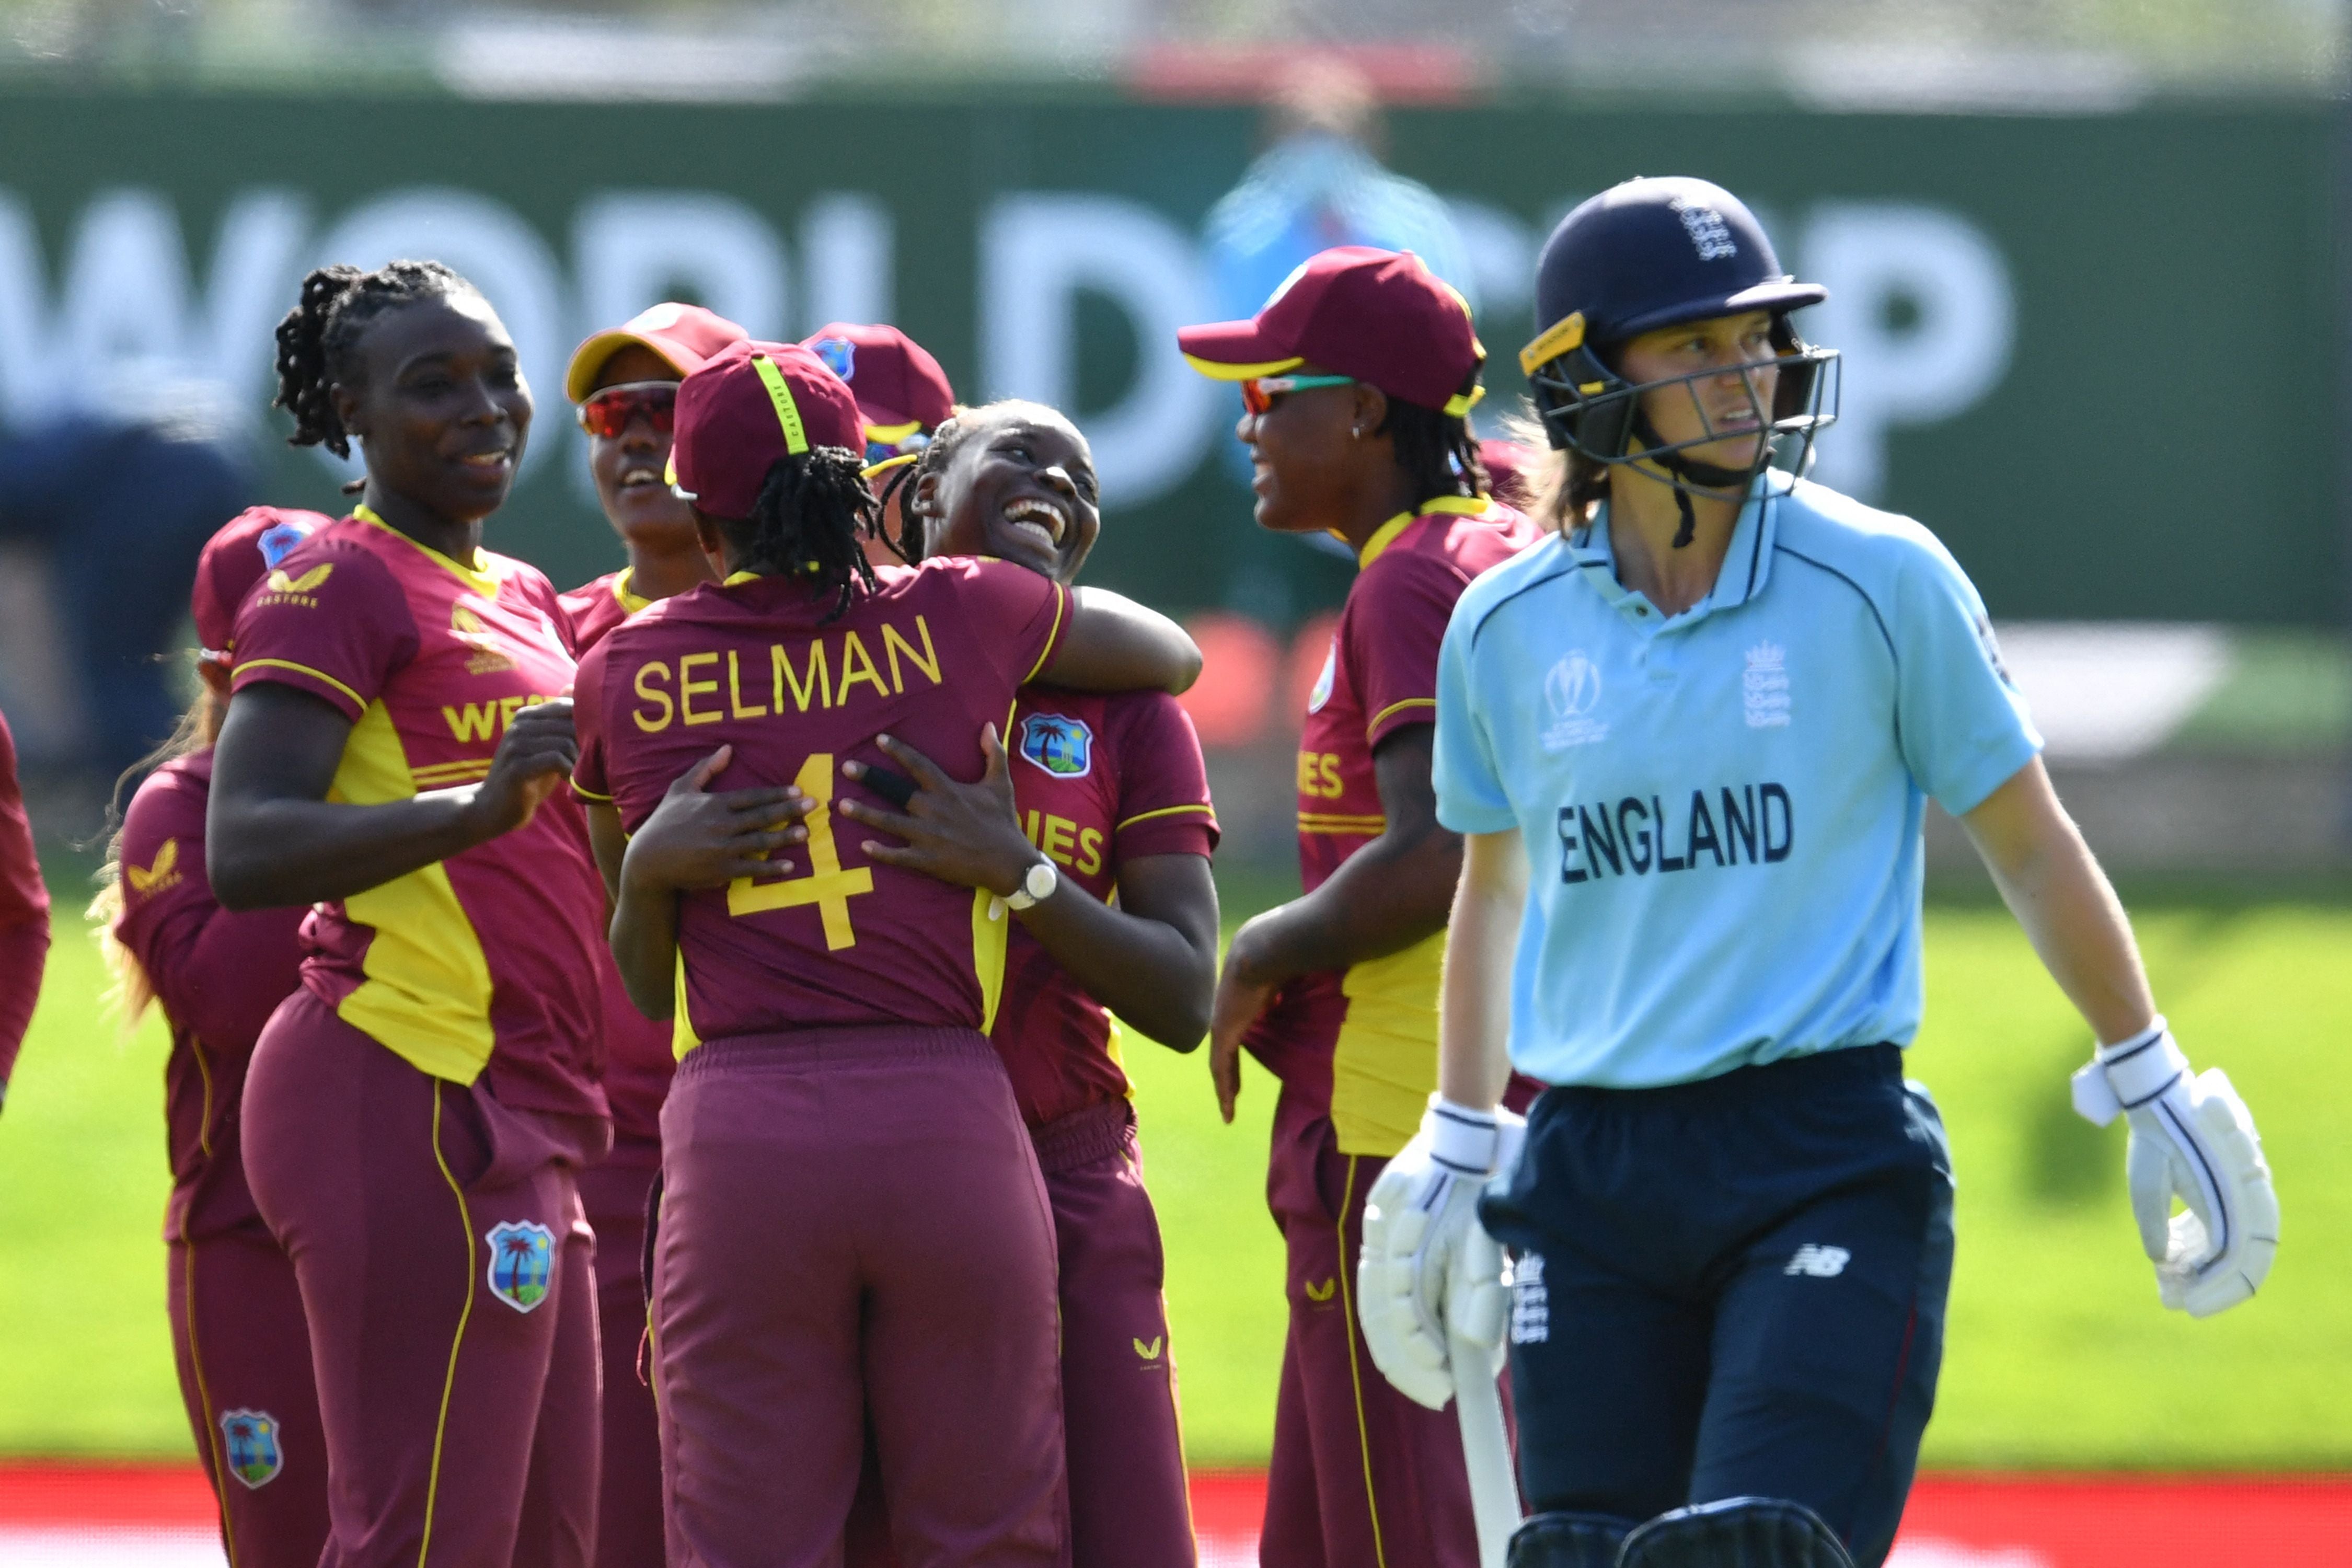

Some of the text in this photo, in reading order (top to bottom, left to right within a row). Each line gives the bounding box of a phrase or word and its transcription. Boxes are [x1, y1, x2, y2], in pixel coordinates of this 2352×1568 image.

[441, 694, 562, 743] WE
[632, 615, 942, 733] SELMAN
[727, 753, 874, 951] 4
[1017, 809, 1104, 876] IES
[1558, 782, 1795, 884] ENGLAND
